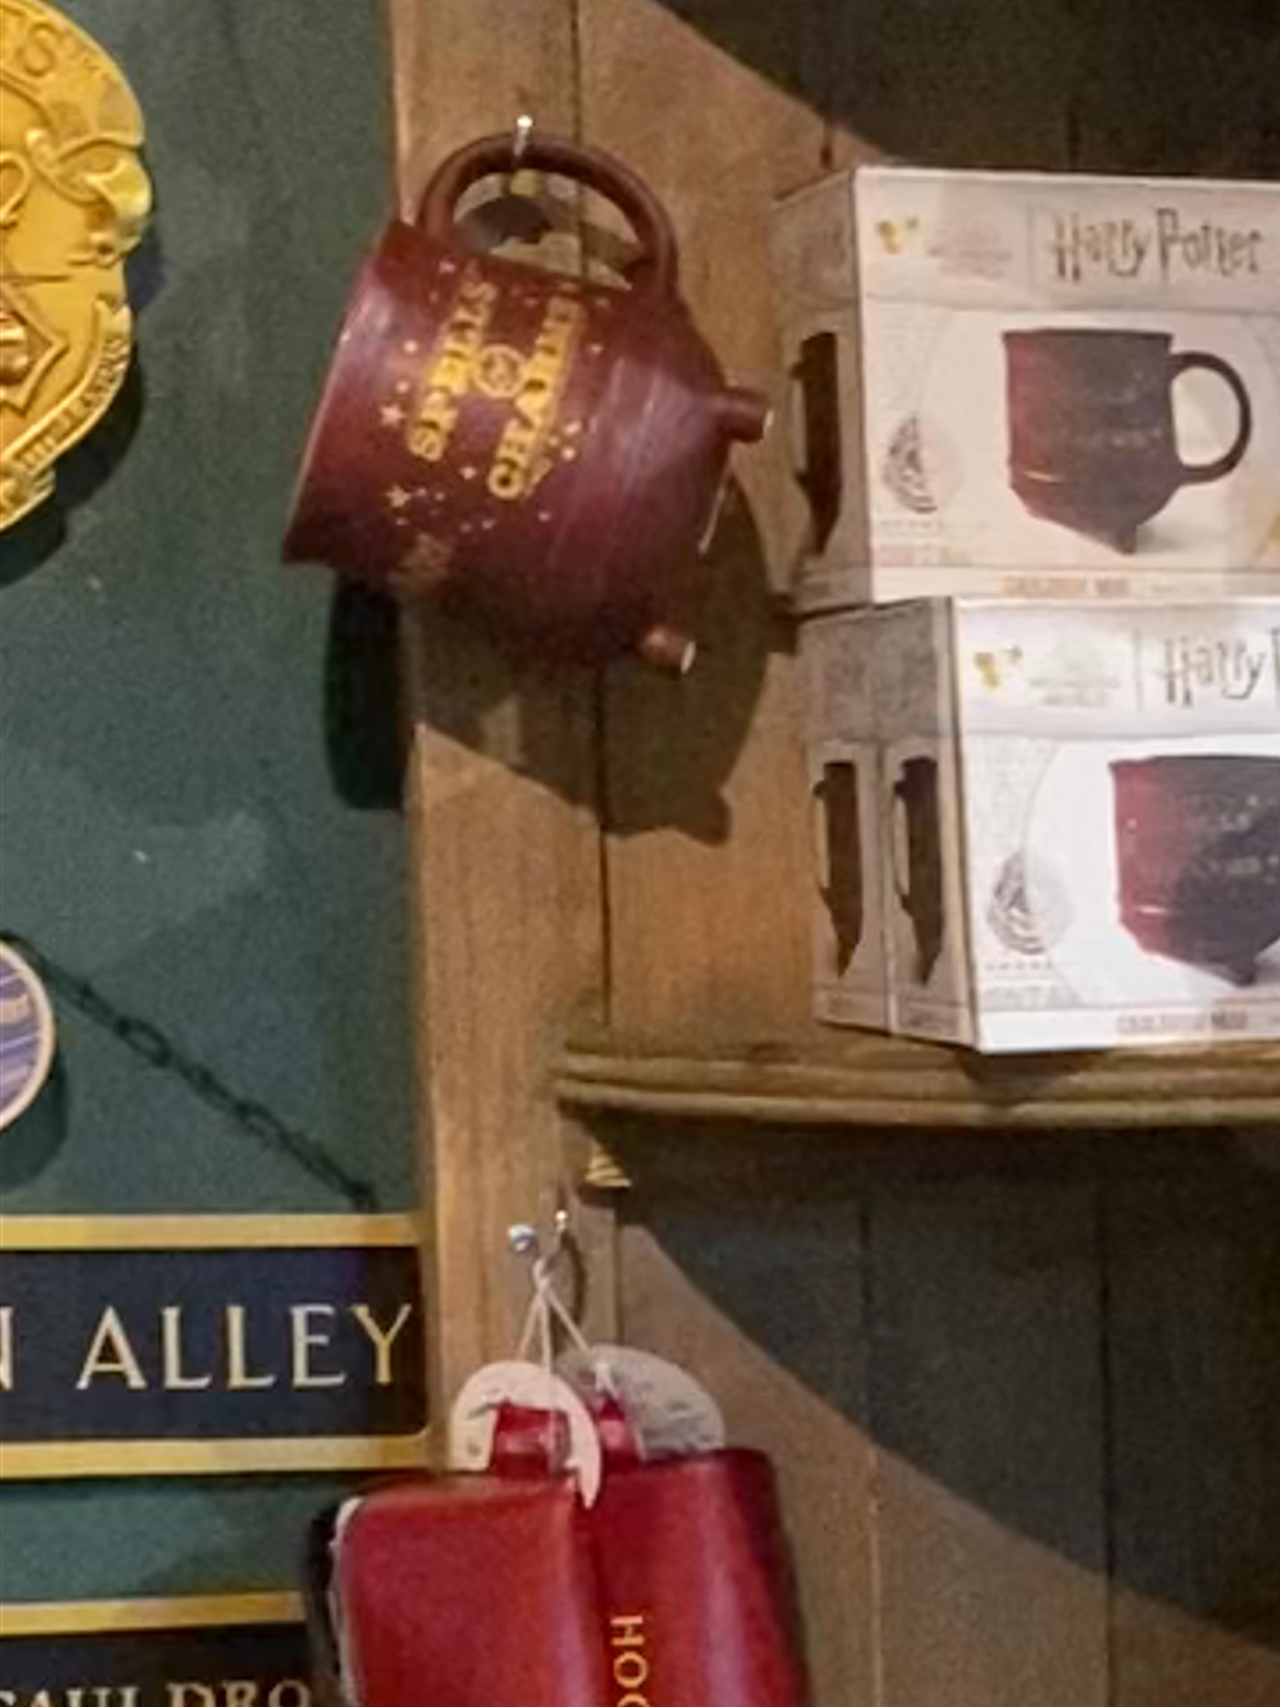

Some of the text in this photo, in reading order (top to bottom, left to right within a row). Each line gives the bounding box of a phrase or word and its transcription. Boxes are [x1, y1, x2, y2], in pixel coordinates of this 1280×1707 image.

[1052, 207, 1262, 290] Harry Potter
[1165, 636, 1267, 708] Harry
[76, 1304, 413, 1390] ALLEY
